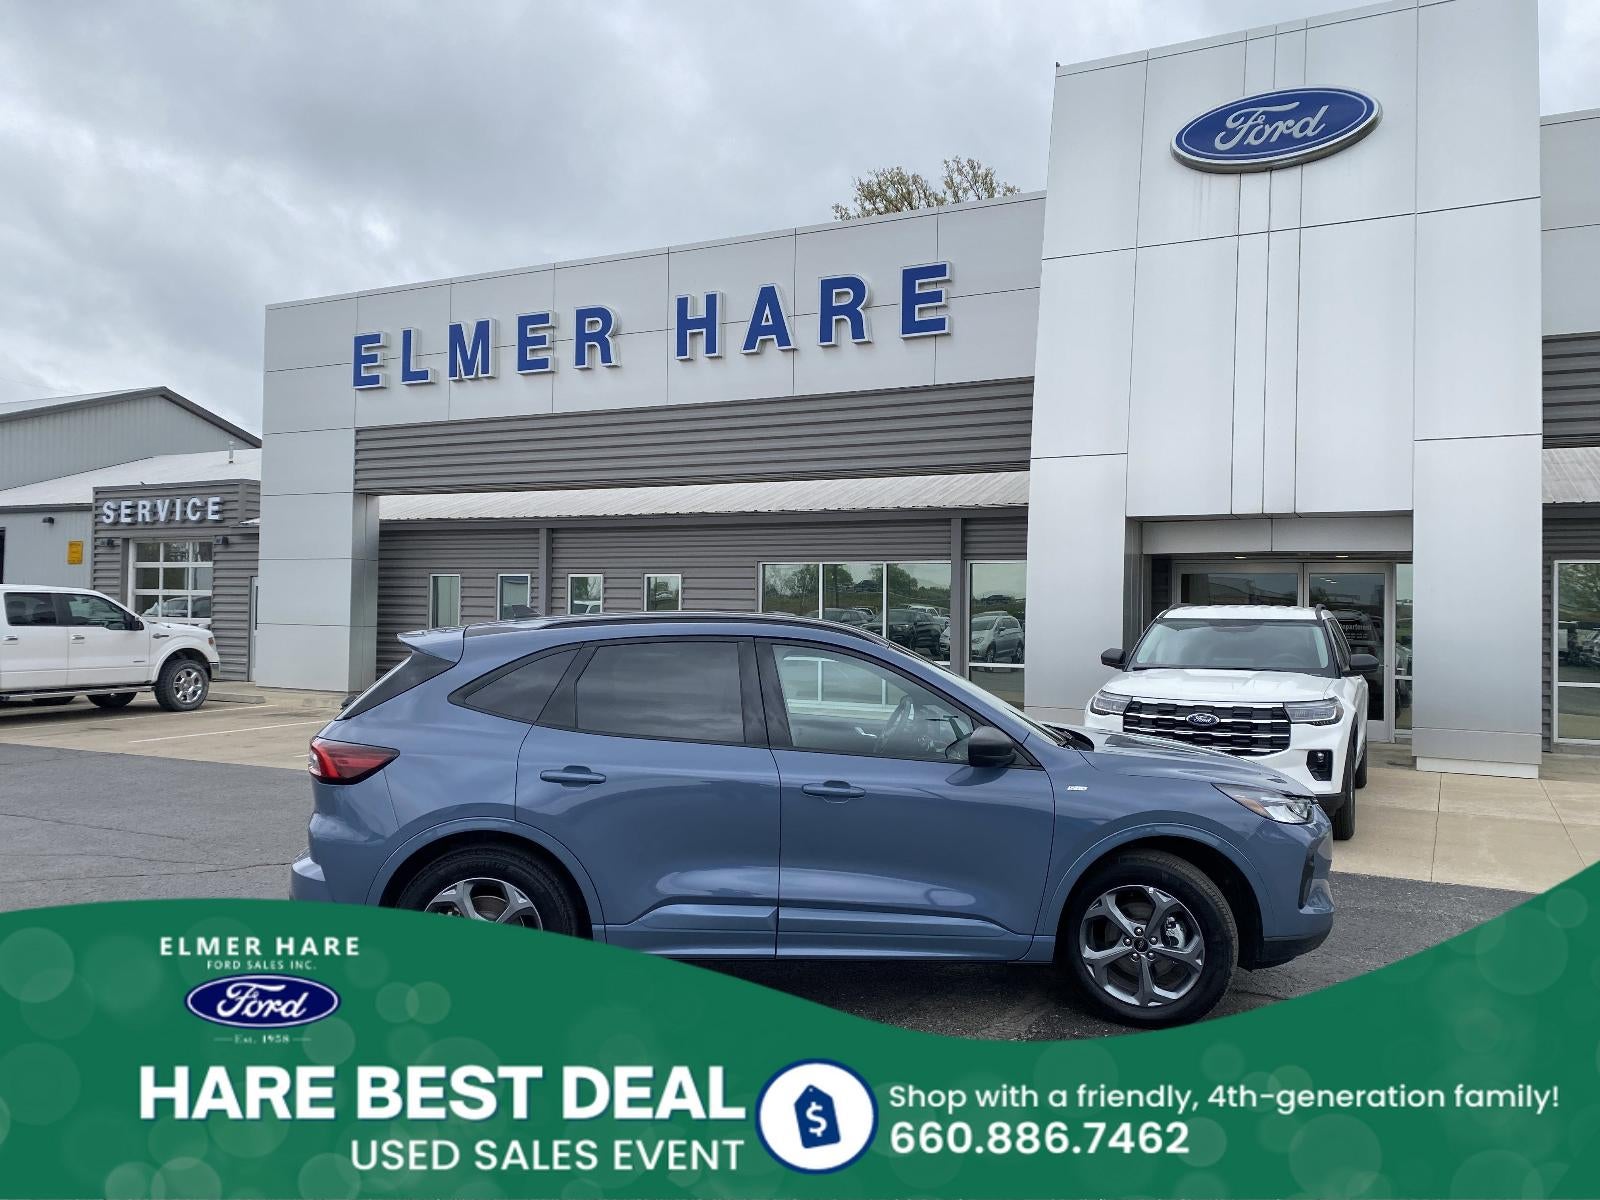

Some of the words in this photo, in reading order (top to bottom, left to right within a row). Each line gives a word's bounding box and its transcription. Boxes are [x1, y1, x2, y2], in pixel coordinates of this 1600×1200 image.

[1214, 101, 1330, 151] Ford
[351, 304, 623, 391] ELMER
[674, 261, 954, 361] HARE
[102, 496, 222, 524] SERVICE
